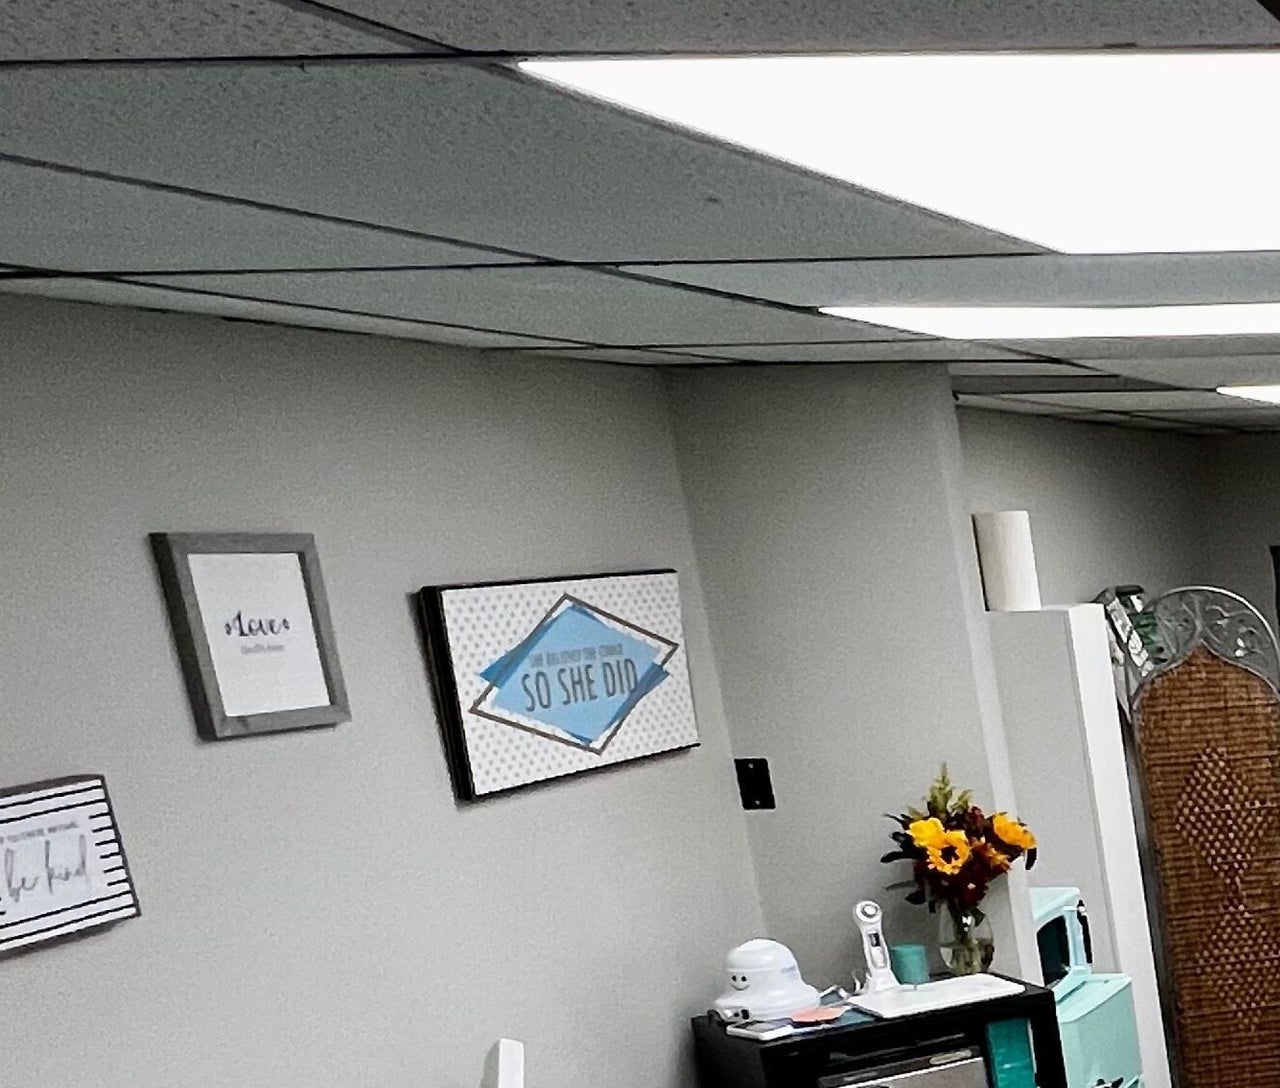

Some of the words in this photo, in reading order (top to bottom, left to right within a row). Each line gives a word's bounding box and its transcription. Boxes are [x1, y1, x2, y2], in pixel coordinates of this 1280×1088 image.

[521, 673, 552, 712] SO
[557, 664, 599, 705] SHE
[602, 658, 638, 697] DID
